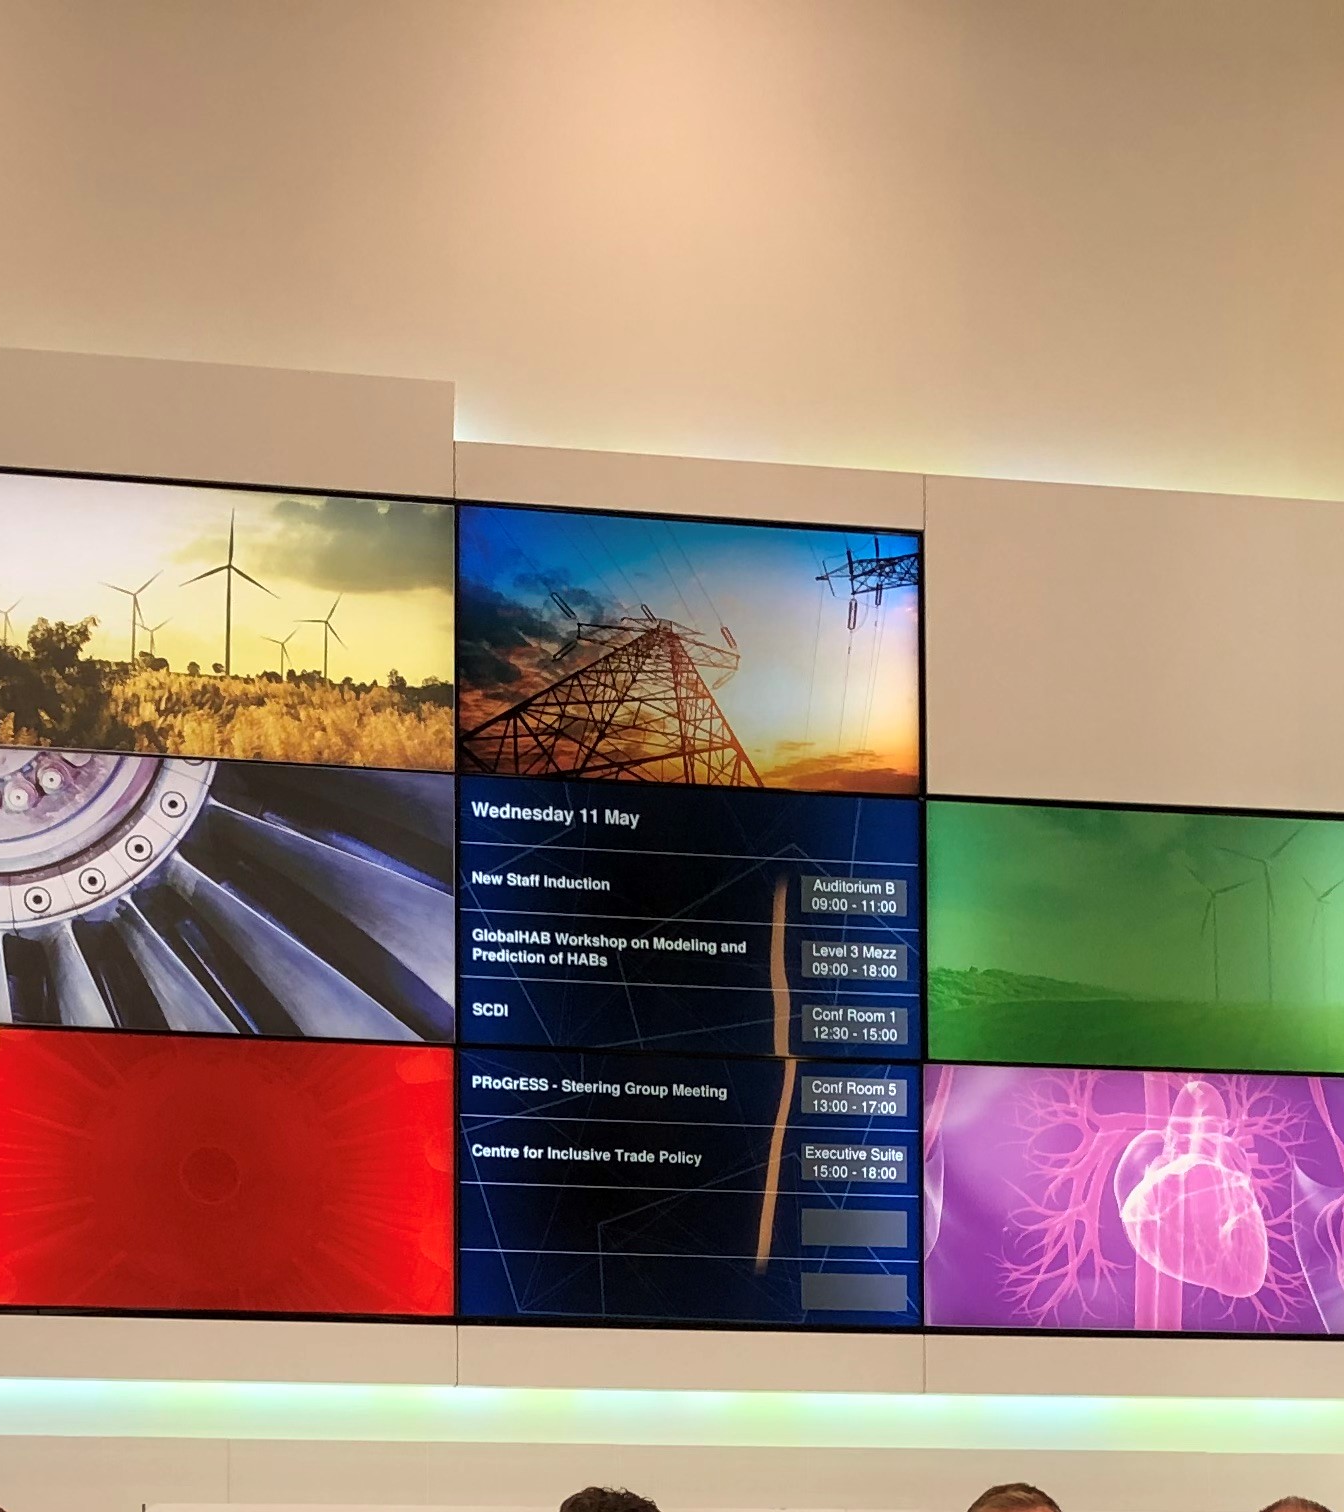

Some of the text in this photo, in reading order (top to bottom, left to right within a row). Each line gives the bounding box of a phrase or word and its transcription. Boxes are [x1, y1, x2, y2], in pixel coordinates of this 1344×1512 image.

[471, 801, 640, 828] Wednesday 11 May
[471, 871, 610, 891] New Staff Induction
[813, 880, 895, 894] Auditorium B
[812, 898, 848, 911] 09:00
[860, 899, 897, 913] 11:00
[472, 929, 746, 953] GlobalHAB Workshop on Modeling and
[472, 948, 608, 967] Prediction of HABs
[812, 944, 897, 960] Level 3 Mezz
[812, 963, 849, 976] 09:00
[862, 964, 897, 978] 18:00
[472, 1003, 508, 1017] SCDI
[812, 1008, 896, 1023] Conf Room 1
[813, 1027, 848, 1041] 12:30
[862, 1028, 898, 1041] 15:00
[472, 1075, 549, 1091] PRoGrESS
[561, 1079, 620, 1098] Steering
[624, 1083, 669, 1099] Group
[672, 1084, 727, 1101] Meeting
[812, 1081, 896, 1096] Conf Room 5
[812, 1100, 848, 1113] 13:00
[861, 1101, 897, 1114] 17:00
[471, 1143, 702, 1167] Centre for Inclusive Trade Policy
[805, 1146, 903, 1162] Executive Suite
[812, 1166, 848, 1179] 15:00
[862, 1167, 897, 1180] 18:00
